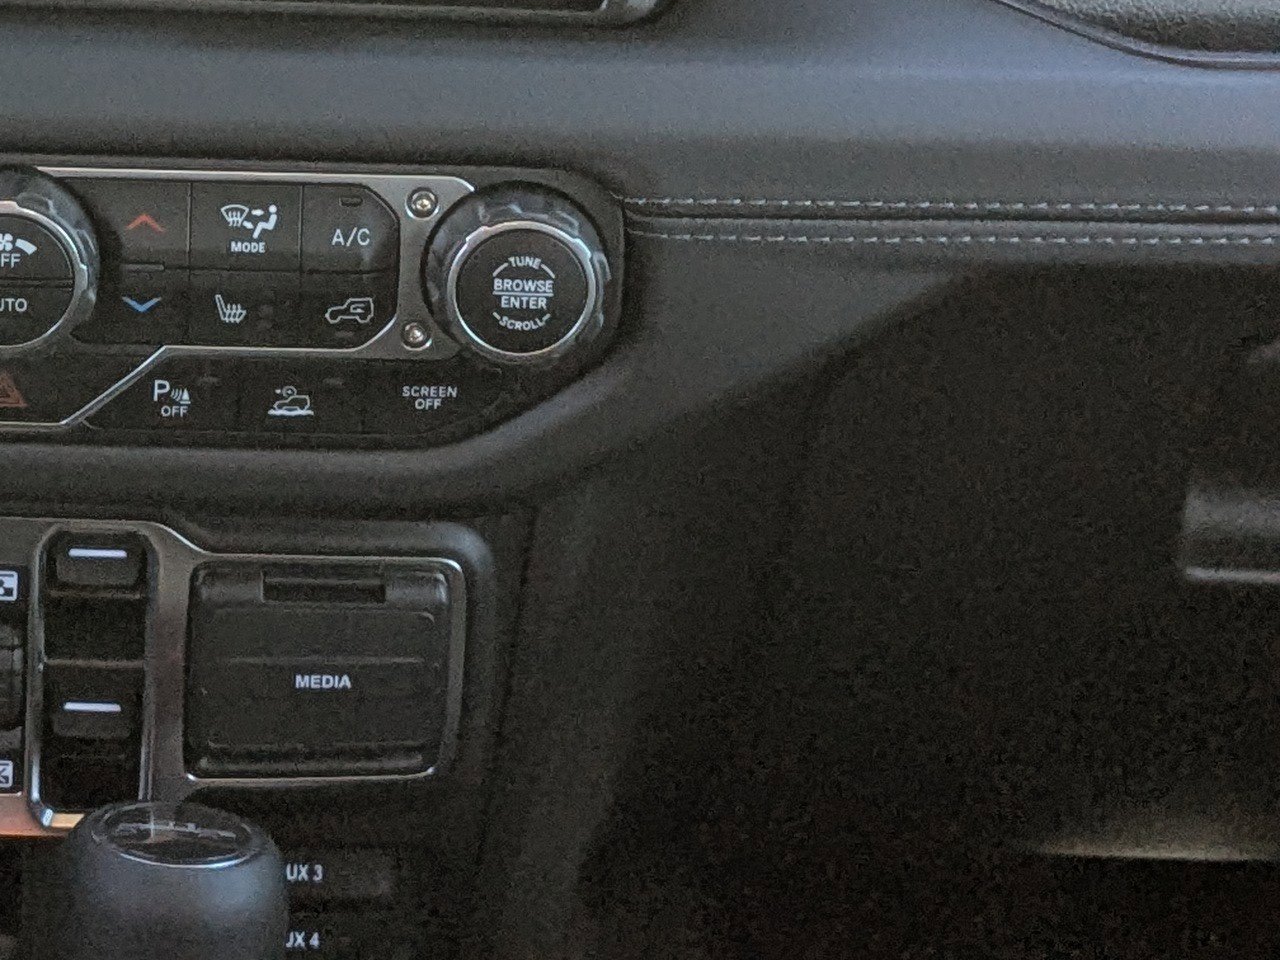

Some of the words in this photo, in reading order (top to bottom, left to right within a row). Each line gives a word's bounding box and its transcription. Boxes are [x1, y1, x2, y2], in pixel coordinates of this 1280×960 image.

[331, 227, 370, 247] A/C
[230, 241, 266, 253] MODE
[508, 256, 542, 270] TUNE
[493, 278, 554, 293] BROWSE
[501, 297, 548, 310] ENTER
[499, 315, 549, 330] SCROLL
[402, 386, 458, 398] SCREEN
[161, 406, 188, 417] OFF
[415, 399, 442, 410] OFF
[295, 674, 351, 689] MEDIA
[286, 863, 308, 881] UX
